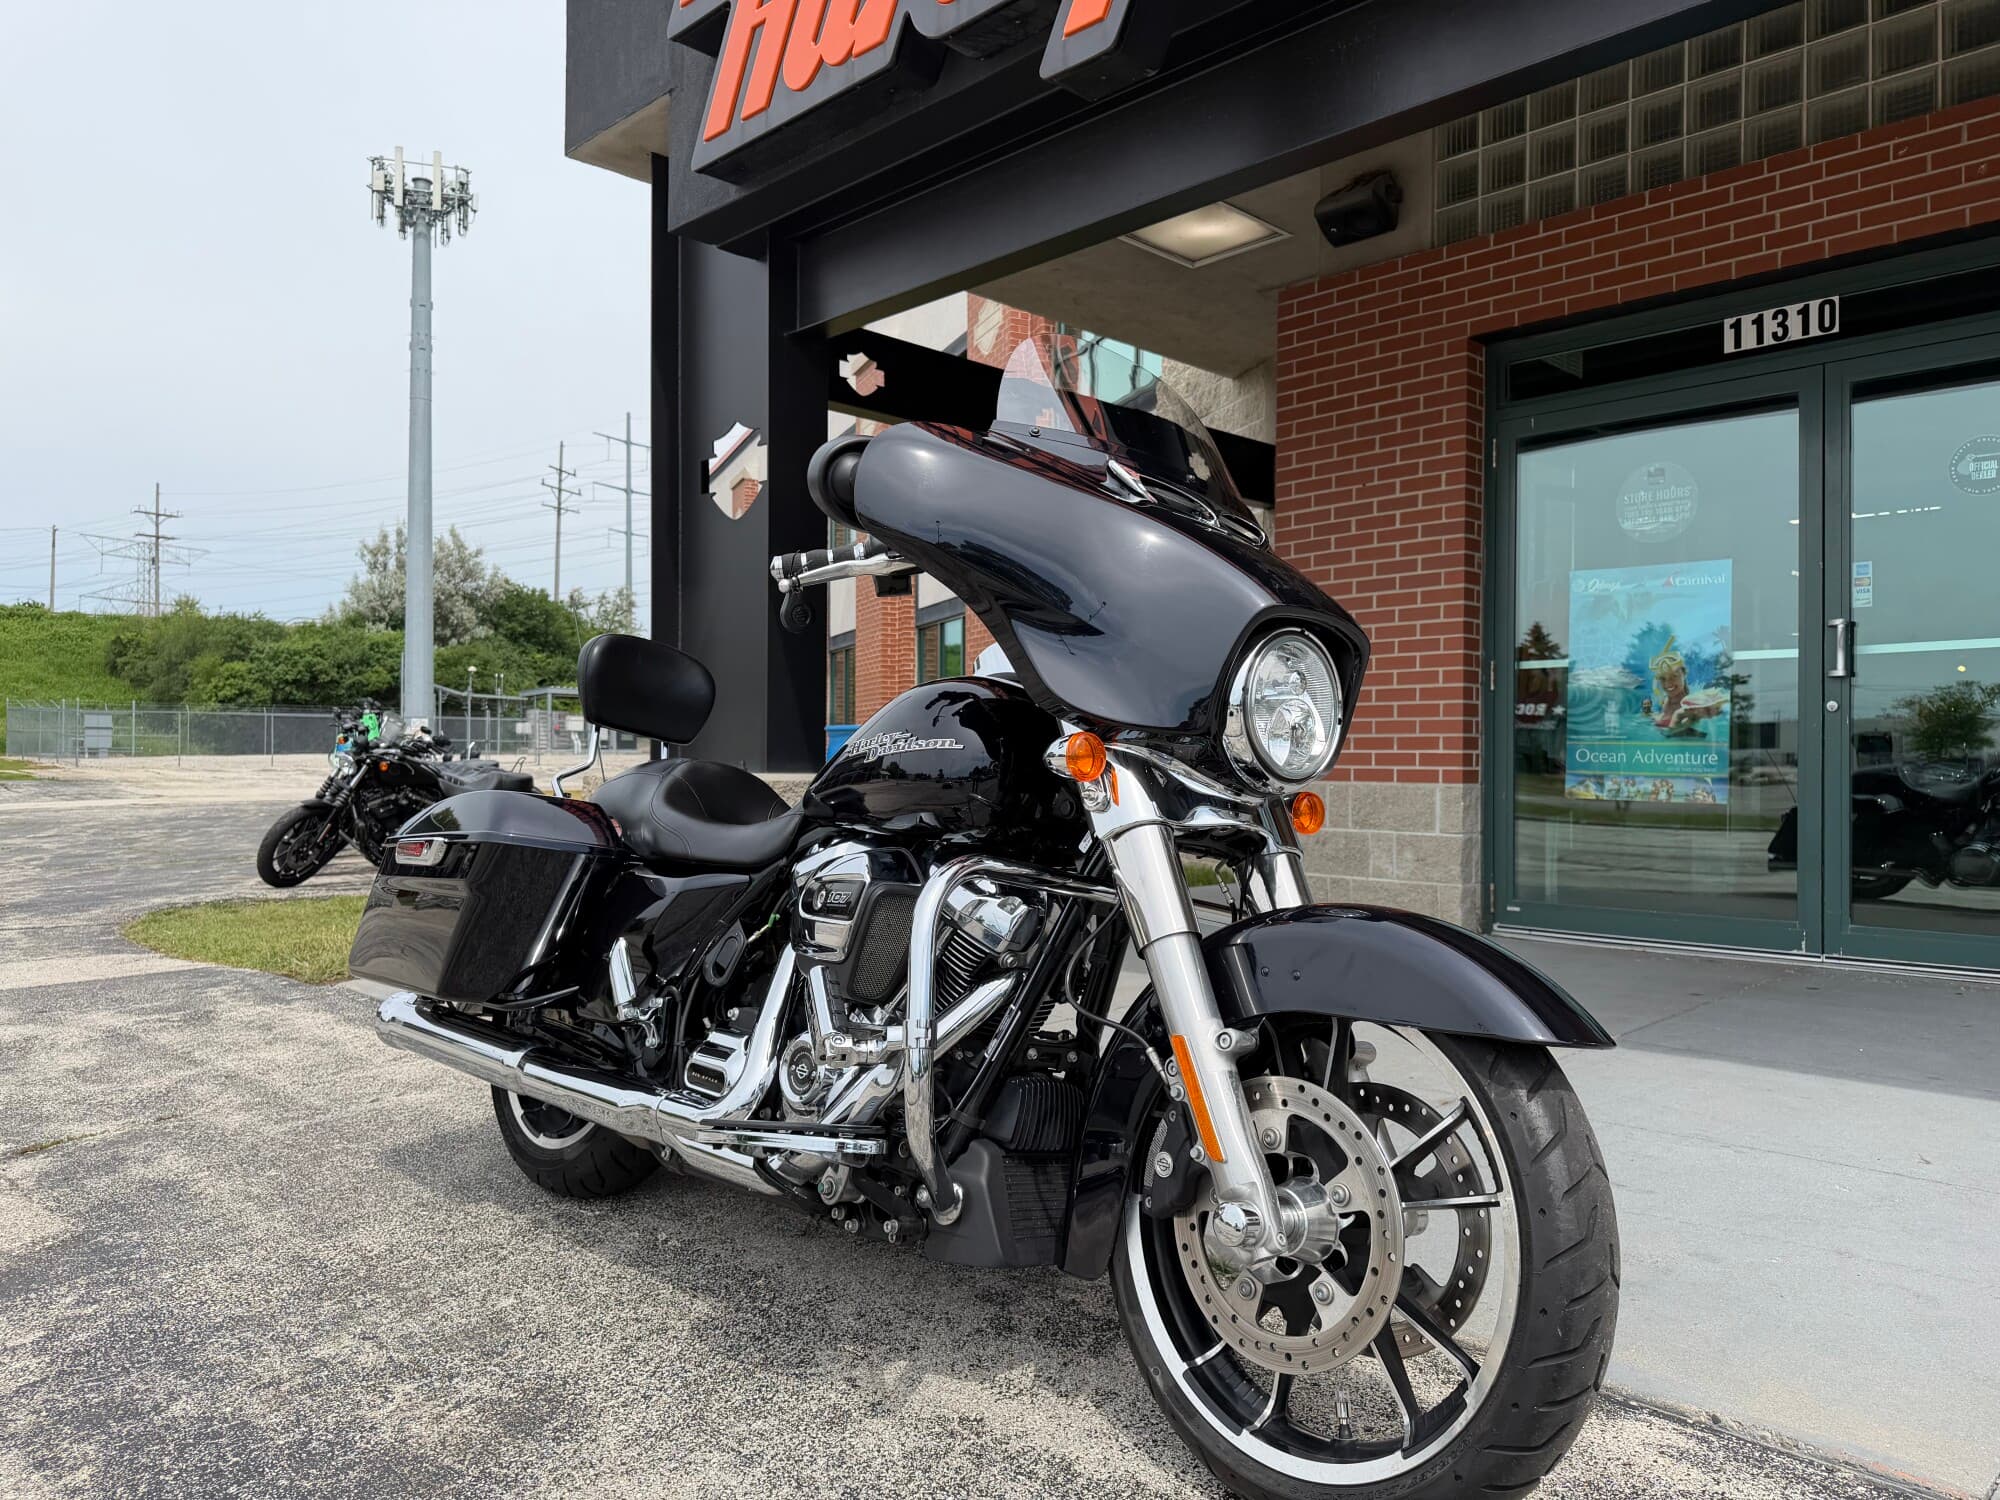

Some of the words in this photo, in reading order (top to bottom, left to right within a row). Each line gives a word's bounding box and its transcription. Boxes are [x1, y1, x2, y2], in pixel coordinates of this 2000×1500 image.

[1729, 298, 1837, 350] 11310
[1675, 574, 1727, 587] Carnival
[864, 736, 965, 763] Davidson
[1575, 748, 1626, 763] Ocean
[1632, 749, 1718, 765] Adventure
[827, 891, 852, 904] 107
